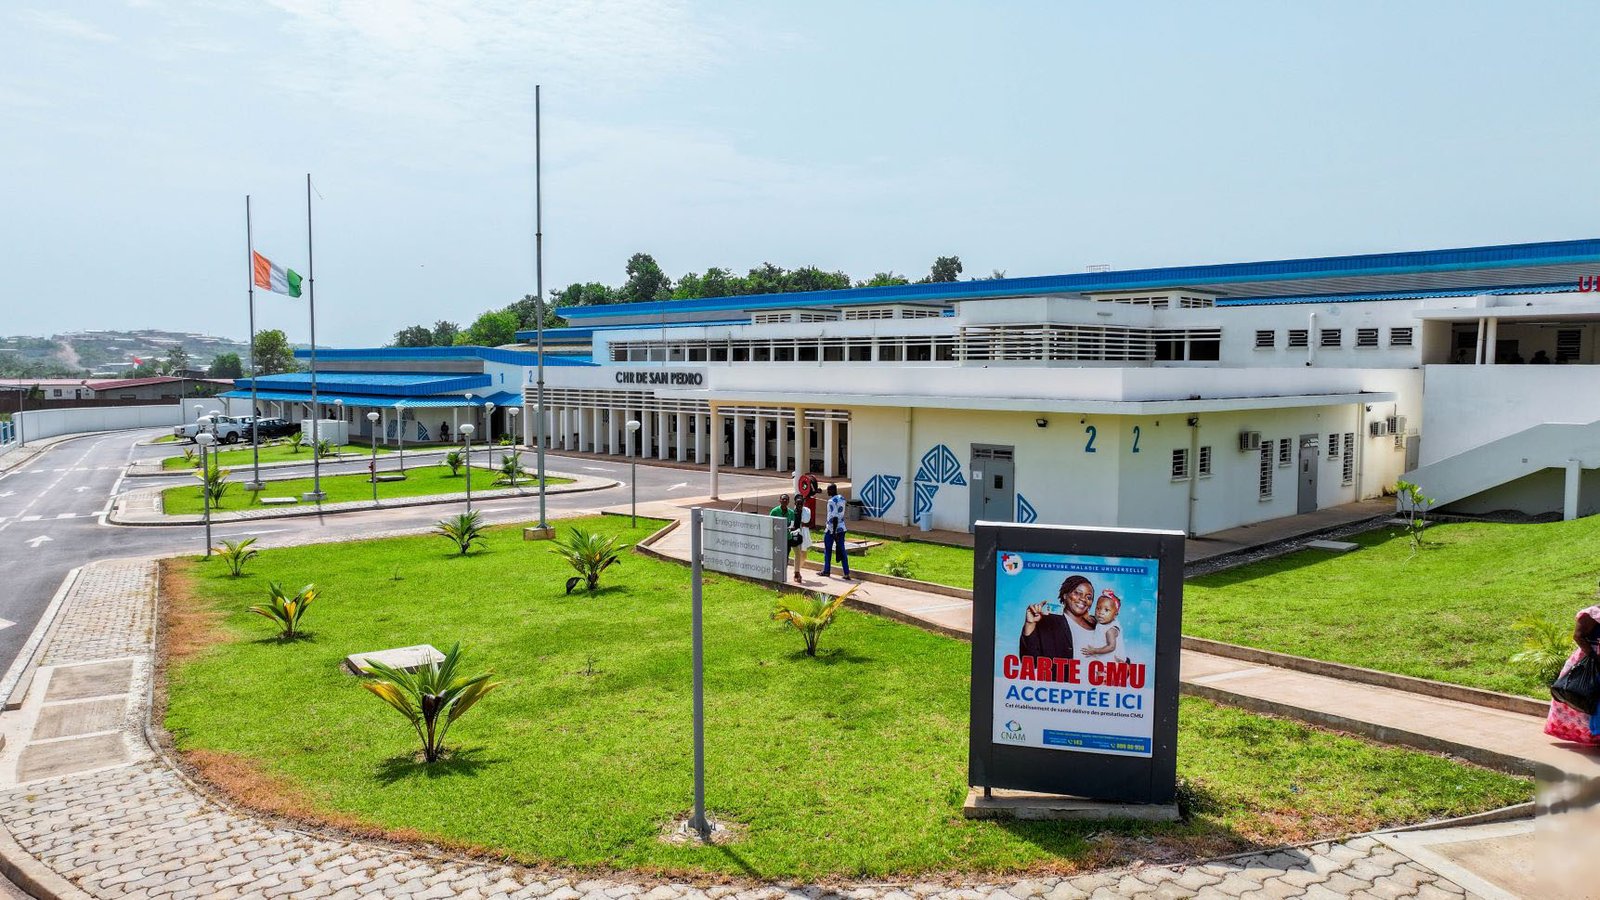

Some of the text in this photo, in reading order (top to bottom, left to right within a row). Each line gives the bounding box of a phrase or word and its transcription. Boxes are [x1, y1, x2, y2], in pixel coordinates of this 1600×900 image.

[500, 372, 504, 384] 1
[528, 370, 533, 383] 2
[616, 371, 703, 386] CHR DE SAN PEDRO
[1085, 425, 1097, 453] 2
[1132, 425, 1140, 453] 2
[716, 537, 760, 551] Administration
[1027, 562, 1068, 570] COUVERTURE
[1003, 654, 1146, 689] CARTE CMU
[1005, 685, 1142, 710] ACCEPTÉE ICI
[1015, 703, 1050, 713] établissement
[1100, 710, 1130, 719] prestations
[1000, 731, 1026, 741] CNAM
